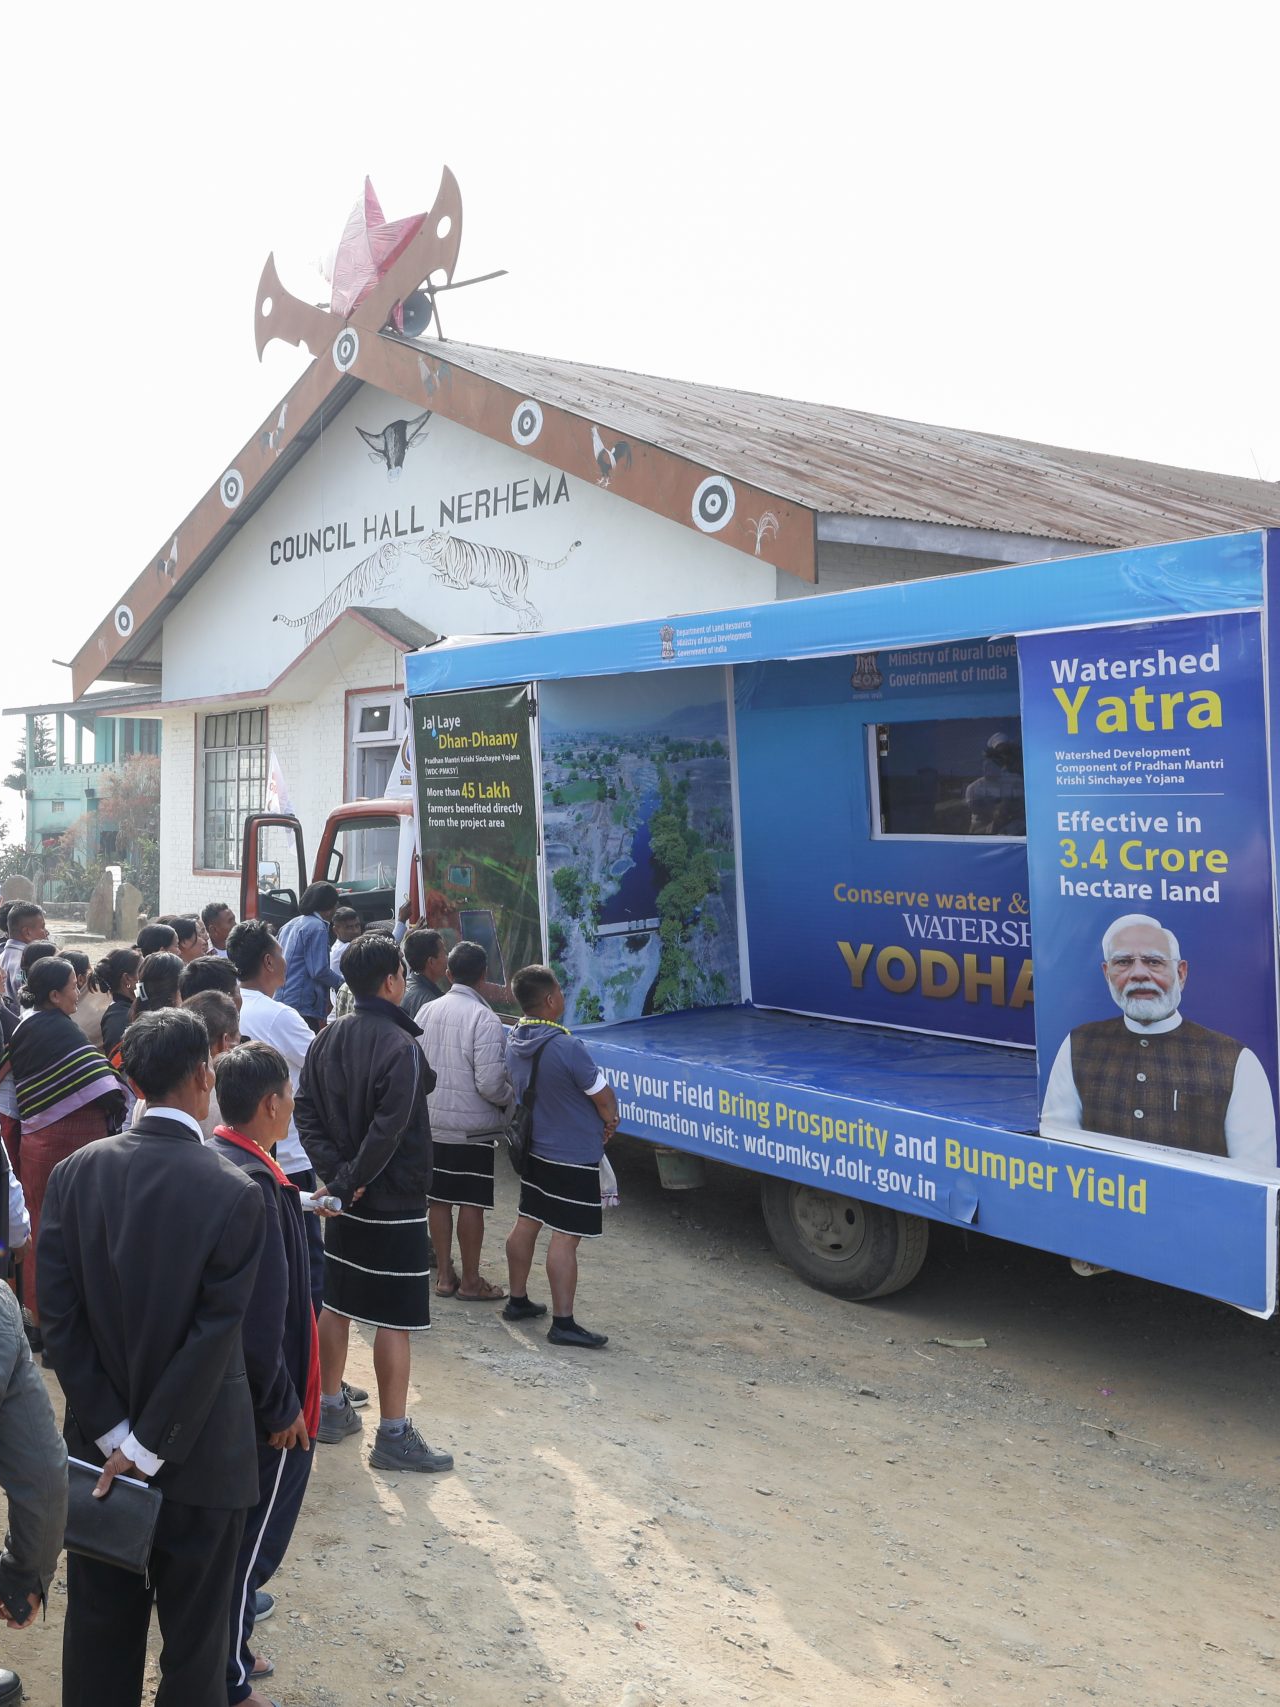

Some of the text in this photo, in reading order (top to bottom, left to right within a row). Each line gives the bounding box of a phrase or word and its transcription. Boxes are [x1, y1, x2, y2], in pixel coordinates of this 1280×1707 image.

[270, 472, 570, 566] COUNCIL HALL NERHEMA
[677, 628, 705, 637] Department
[713, 624, 724, 632] Land
[677, 638, 697, 646] Ministry
[718, 632, 752, 641] Development
[678, 649, 707, 657] Government
[888, 643, 1017, 667] Ministry of Rural Deve
[1050, 644, 1221, 684] Watershed
[888, 665, 1008, 687] Government of India
[1051, 685, 1223, 735] Yatra
[422, 715, 461, 731] Jal Laye
[438, 731, 518, 750] Dhan-Dhaany
[424, 753, 520, 765] Pradhan Mantri Krishi Sinchayee Yojana
[1055, 747, 1190, 761] Watershed Development
[424, 766, 459, 776] (WDC-PMKSY)
[1055, 759, 1224, 775] Component of Pradhan Mantri
[1056, 774, 1185, 786] Krishi Sinchayee Yojana
[426, 781, 511, 799] More than 45 Lakh
[427, 802, 523, 816] farmers benefited directly
[428, 818, 506, 830] from the project area
[1056, 811, 1202, 833] Effective in
[1059, 838, 1229, 874] 3.4 Crore
[833, 882, 1029, 914] Conserve water &
[1060, 875, 1220, 903] hectare land
[618, 1098, 936, 1201] information visit: wdcpmksy.dolr.gov.in
[632, 1074, 670, 1100] your
[673, 1080, 714, 1111] Field
[718, 1090, 770, 1129] Bring
[776, 1102, 889, 1157] Prosperity
[894, 1132, 937, 1164] and
[944, 1138, 1058, 1193] Bumper
[1066, 1164, 1147, 1215] Yield
